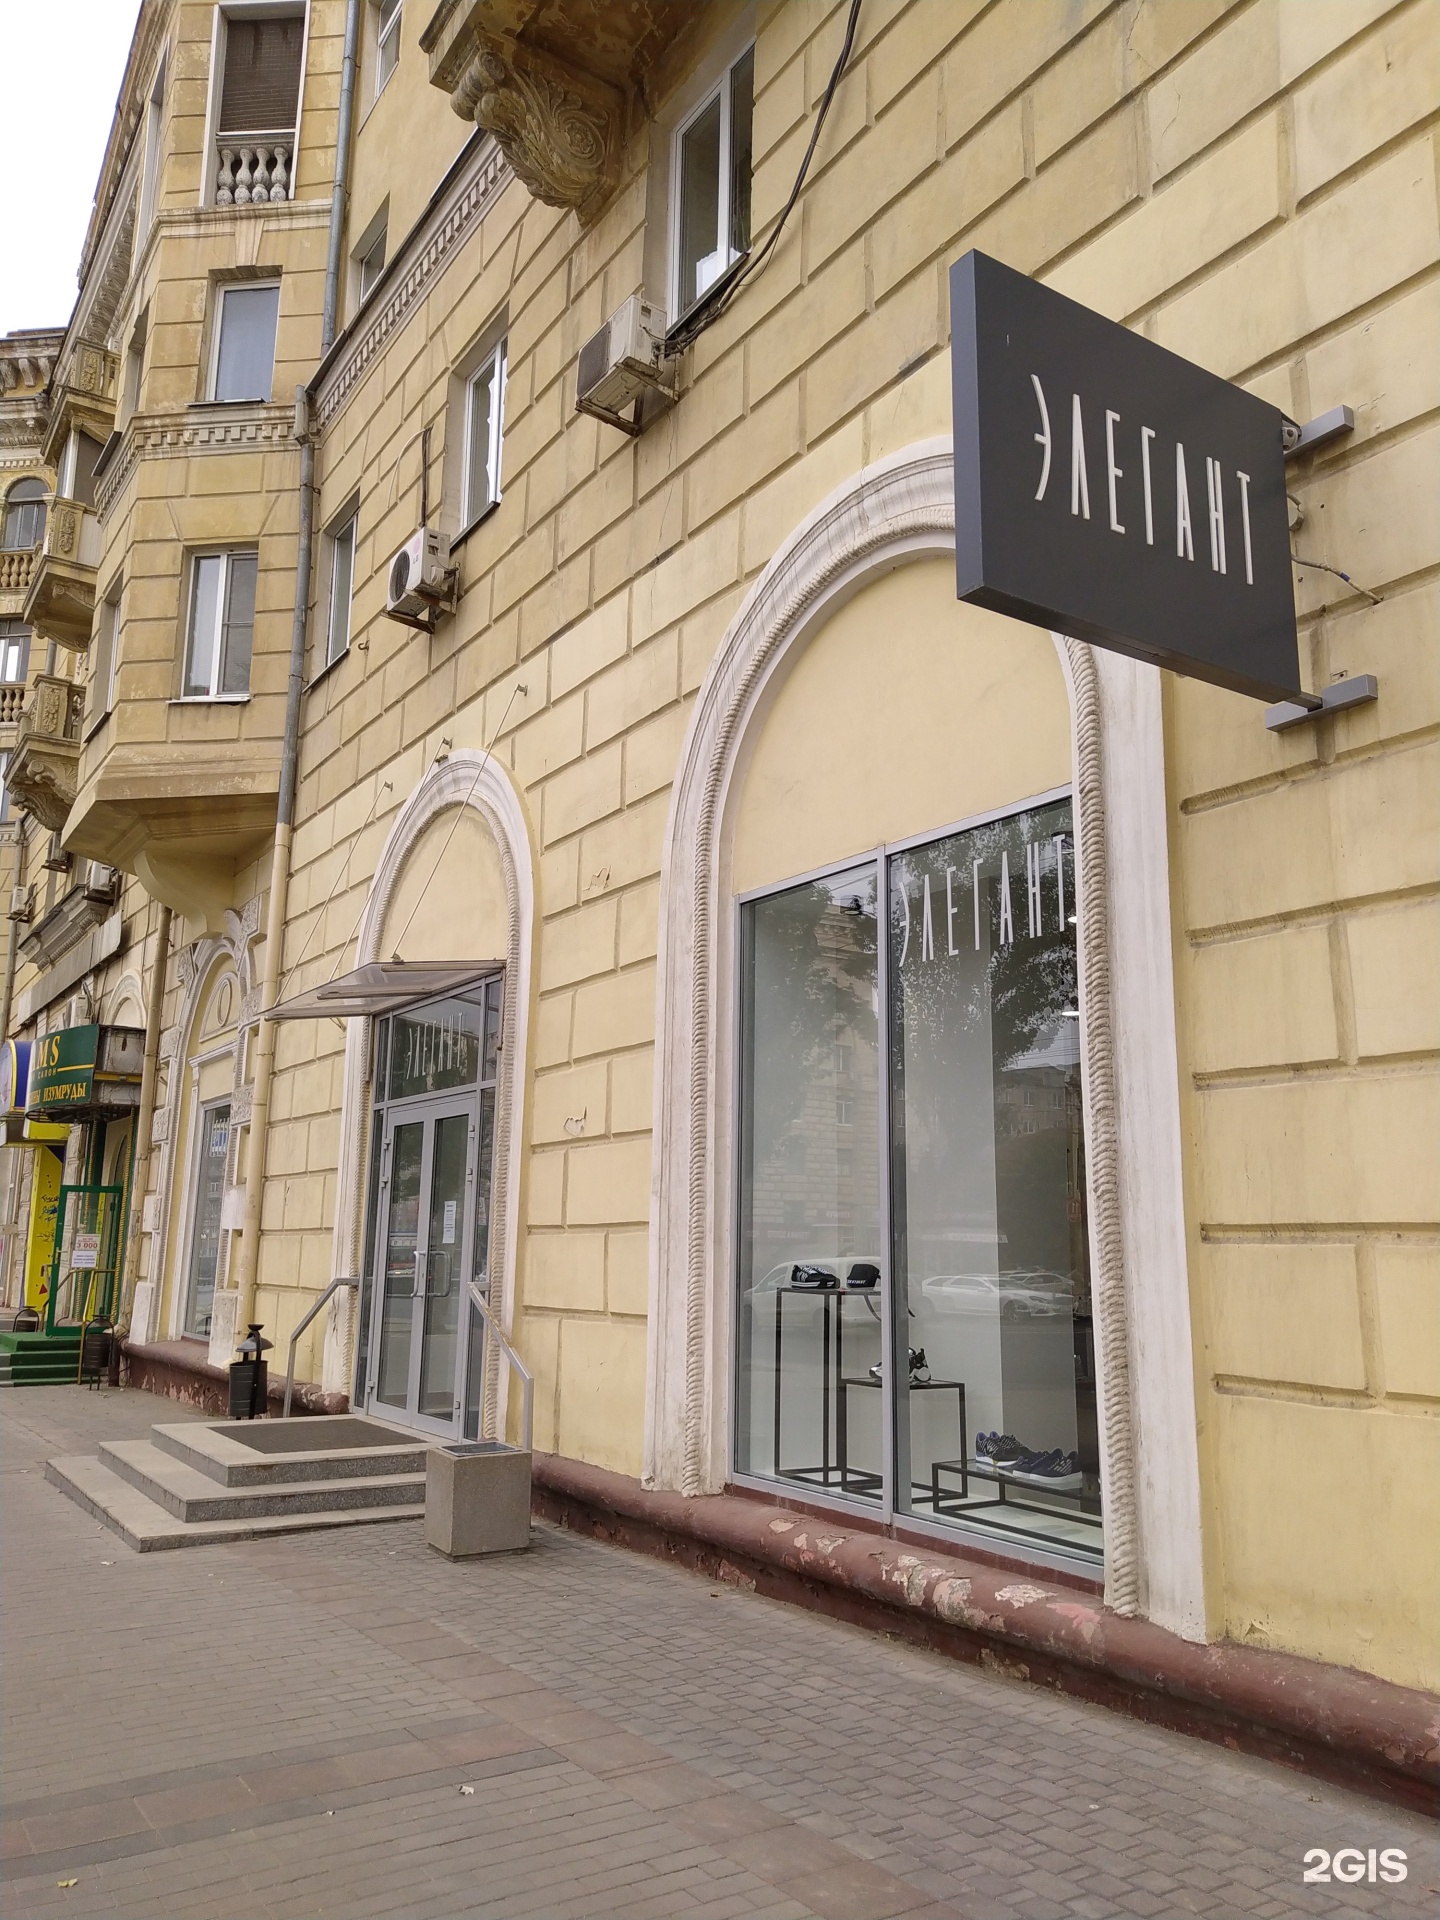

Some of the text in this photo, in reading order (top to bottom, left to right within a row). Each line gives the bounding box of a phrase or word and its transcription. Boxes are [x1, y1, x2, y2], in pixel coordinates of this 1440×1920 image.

[1030, 373, 1254, 586] ЭЛЕГАНТ
[898, 834, 1066, 968] ЭЛЕГАНТ
[43, 1082, 87, 1102] ИЗУМРУДЫ
[406, 1012, 463, 1080] ЭЛЕГАНТ
